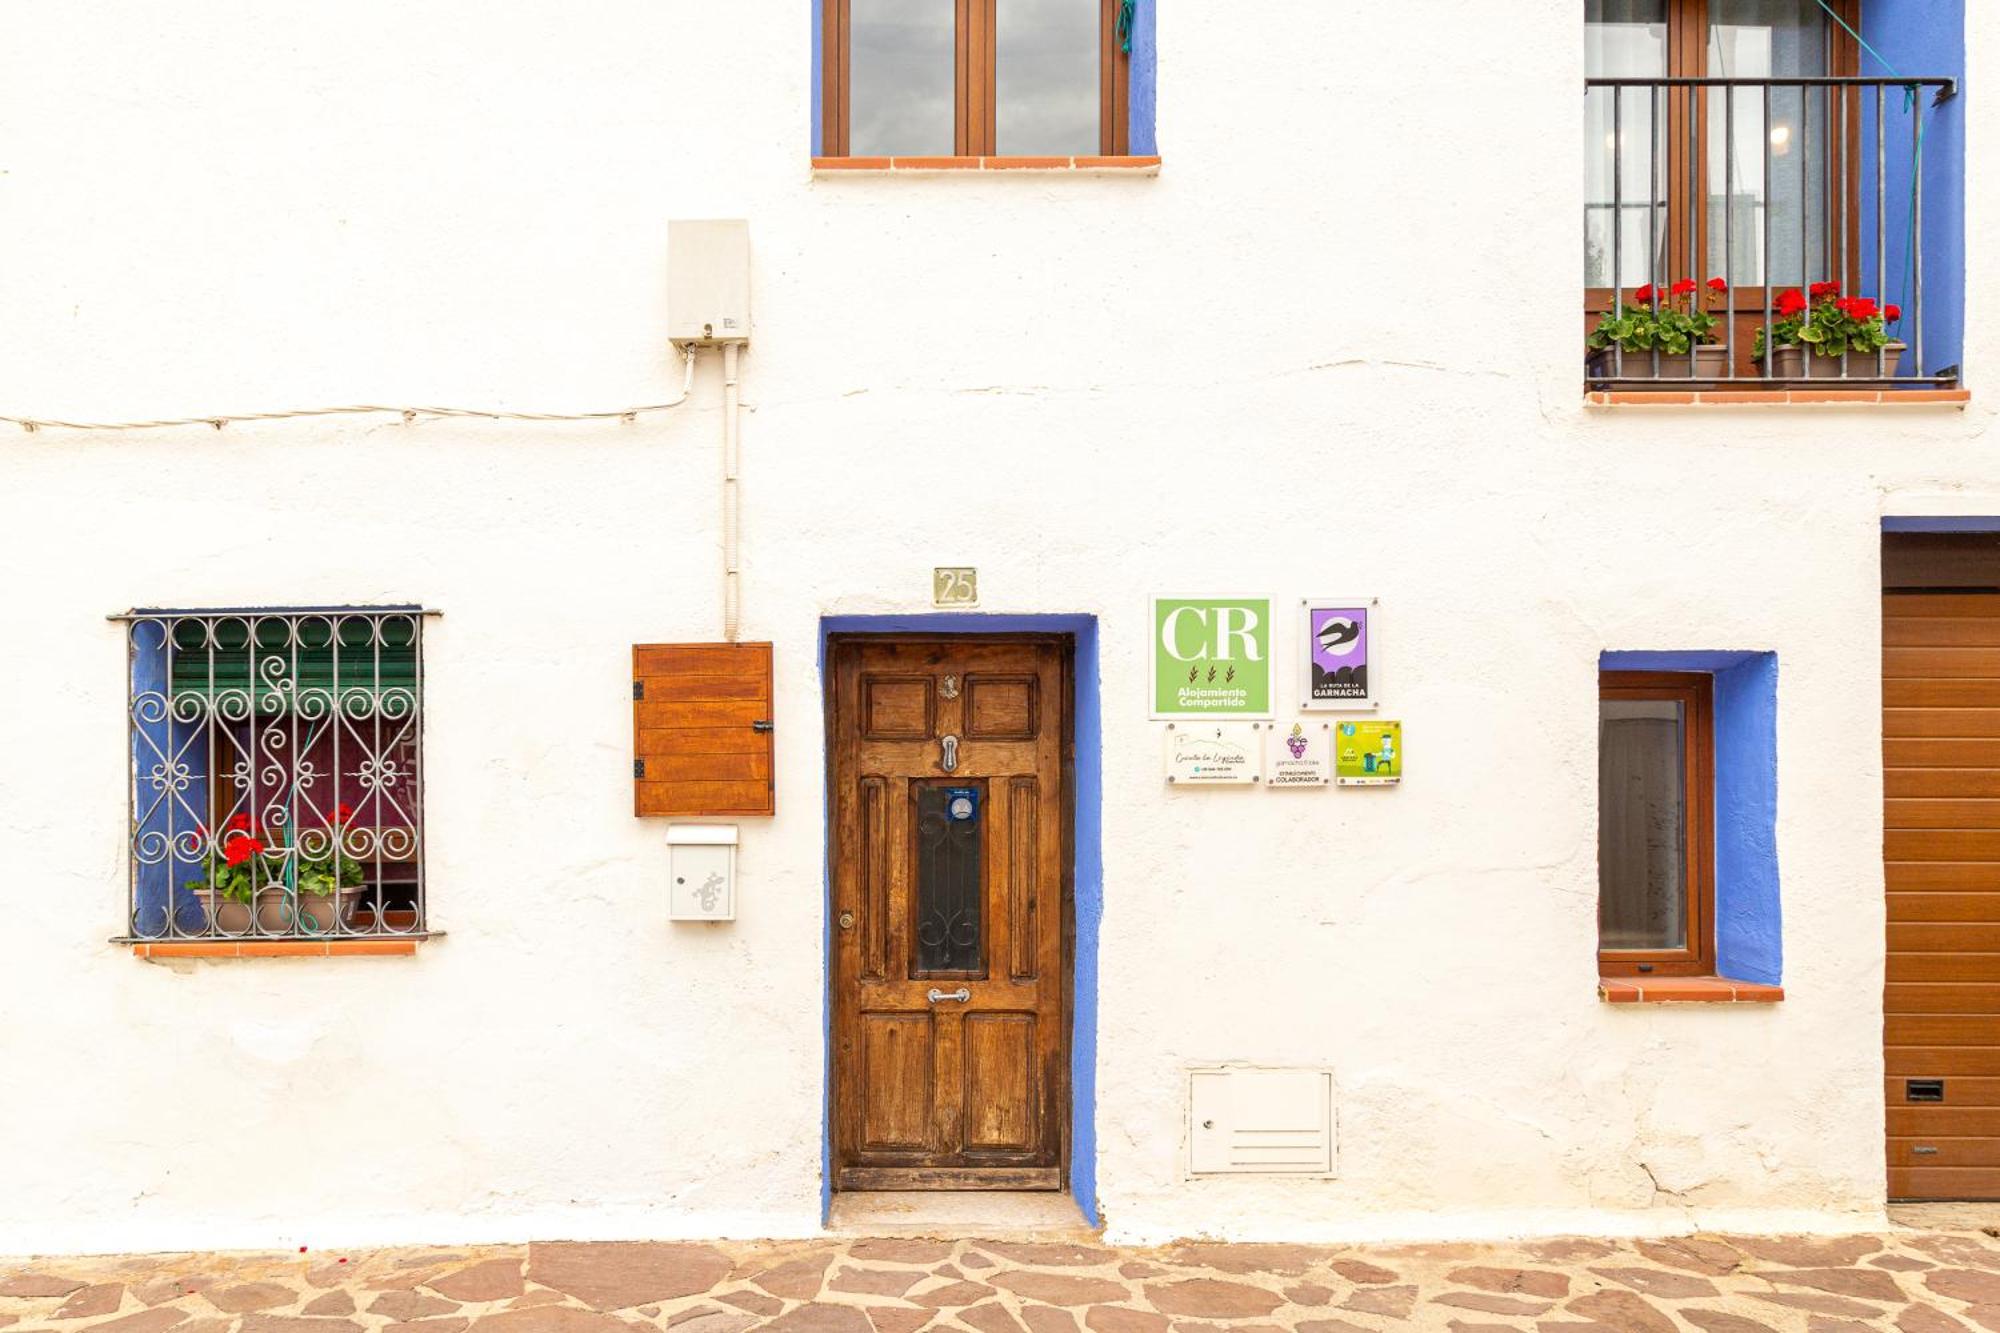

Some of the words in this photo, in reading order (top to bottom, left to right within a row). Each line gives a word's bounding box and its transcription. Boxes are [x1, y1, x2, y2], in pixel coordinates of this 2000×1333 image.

[940, 571, 973, 601] 25
[1161, 606, 1264, 661] CR
[1178, 687, 1247, 699] Alojamiento
[1314, 688, 1366, 697] GARNACHA
[1179, 698, 1246, 708] Compartido
